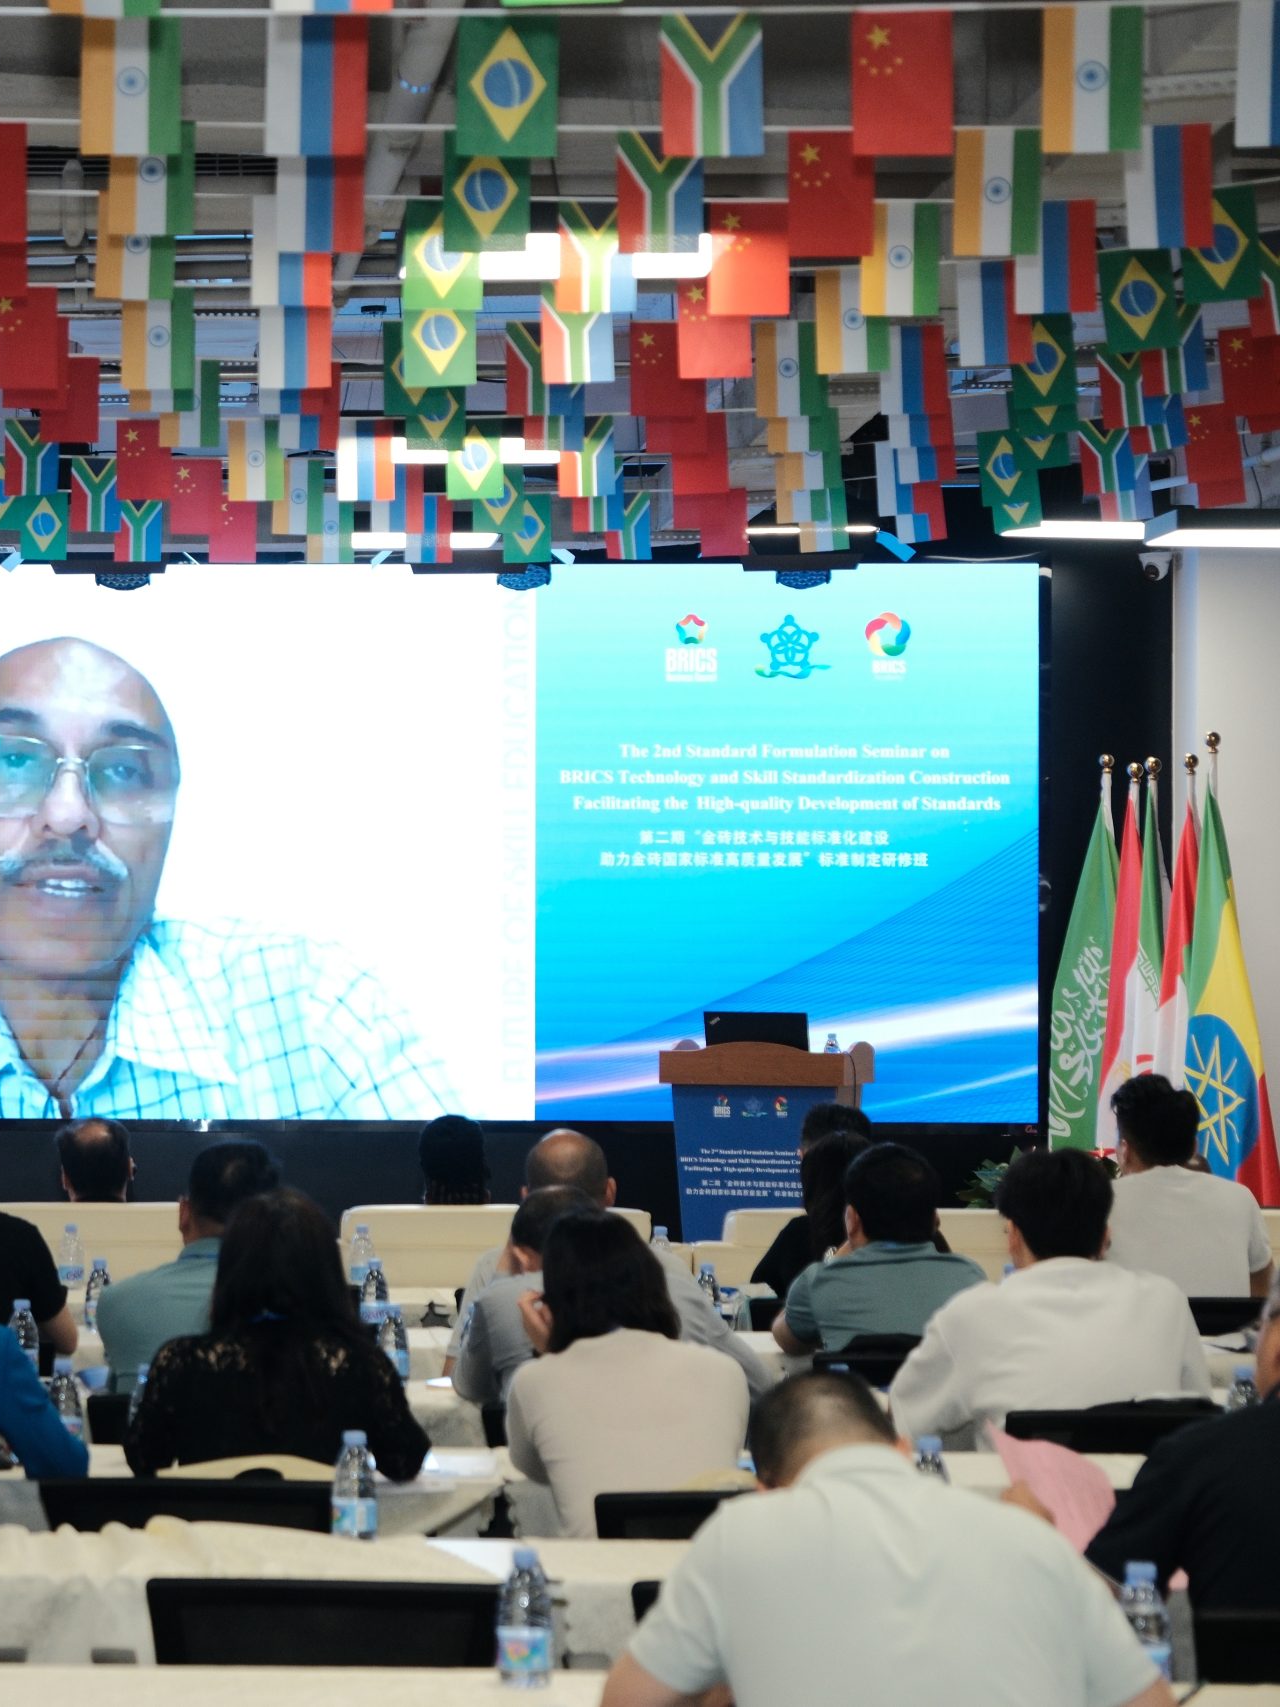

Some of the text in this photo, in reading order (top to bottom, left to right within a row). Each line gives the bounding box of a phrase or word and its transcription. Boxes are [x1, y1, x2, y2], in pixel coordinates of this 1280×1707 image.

[665, 648, 718, 672] BRICS
[620, 743, 950, 759] The 2nd Standard Formulation Seminar on
[560, 769, 1011, 788] BRICS Technology and Skill Standardization Construction
[573, 795, 1002, 814] Facilitating the High-quality Development of Standards
